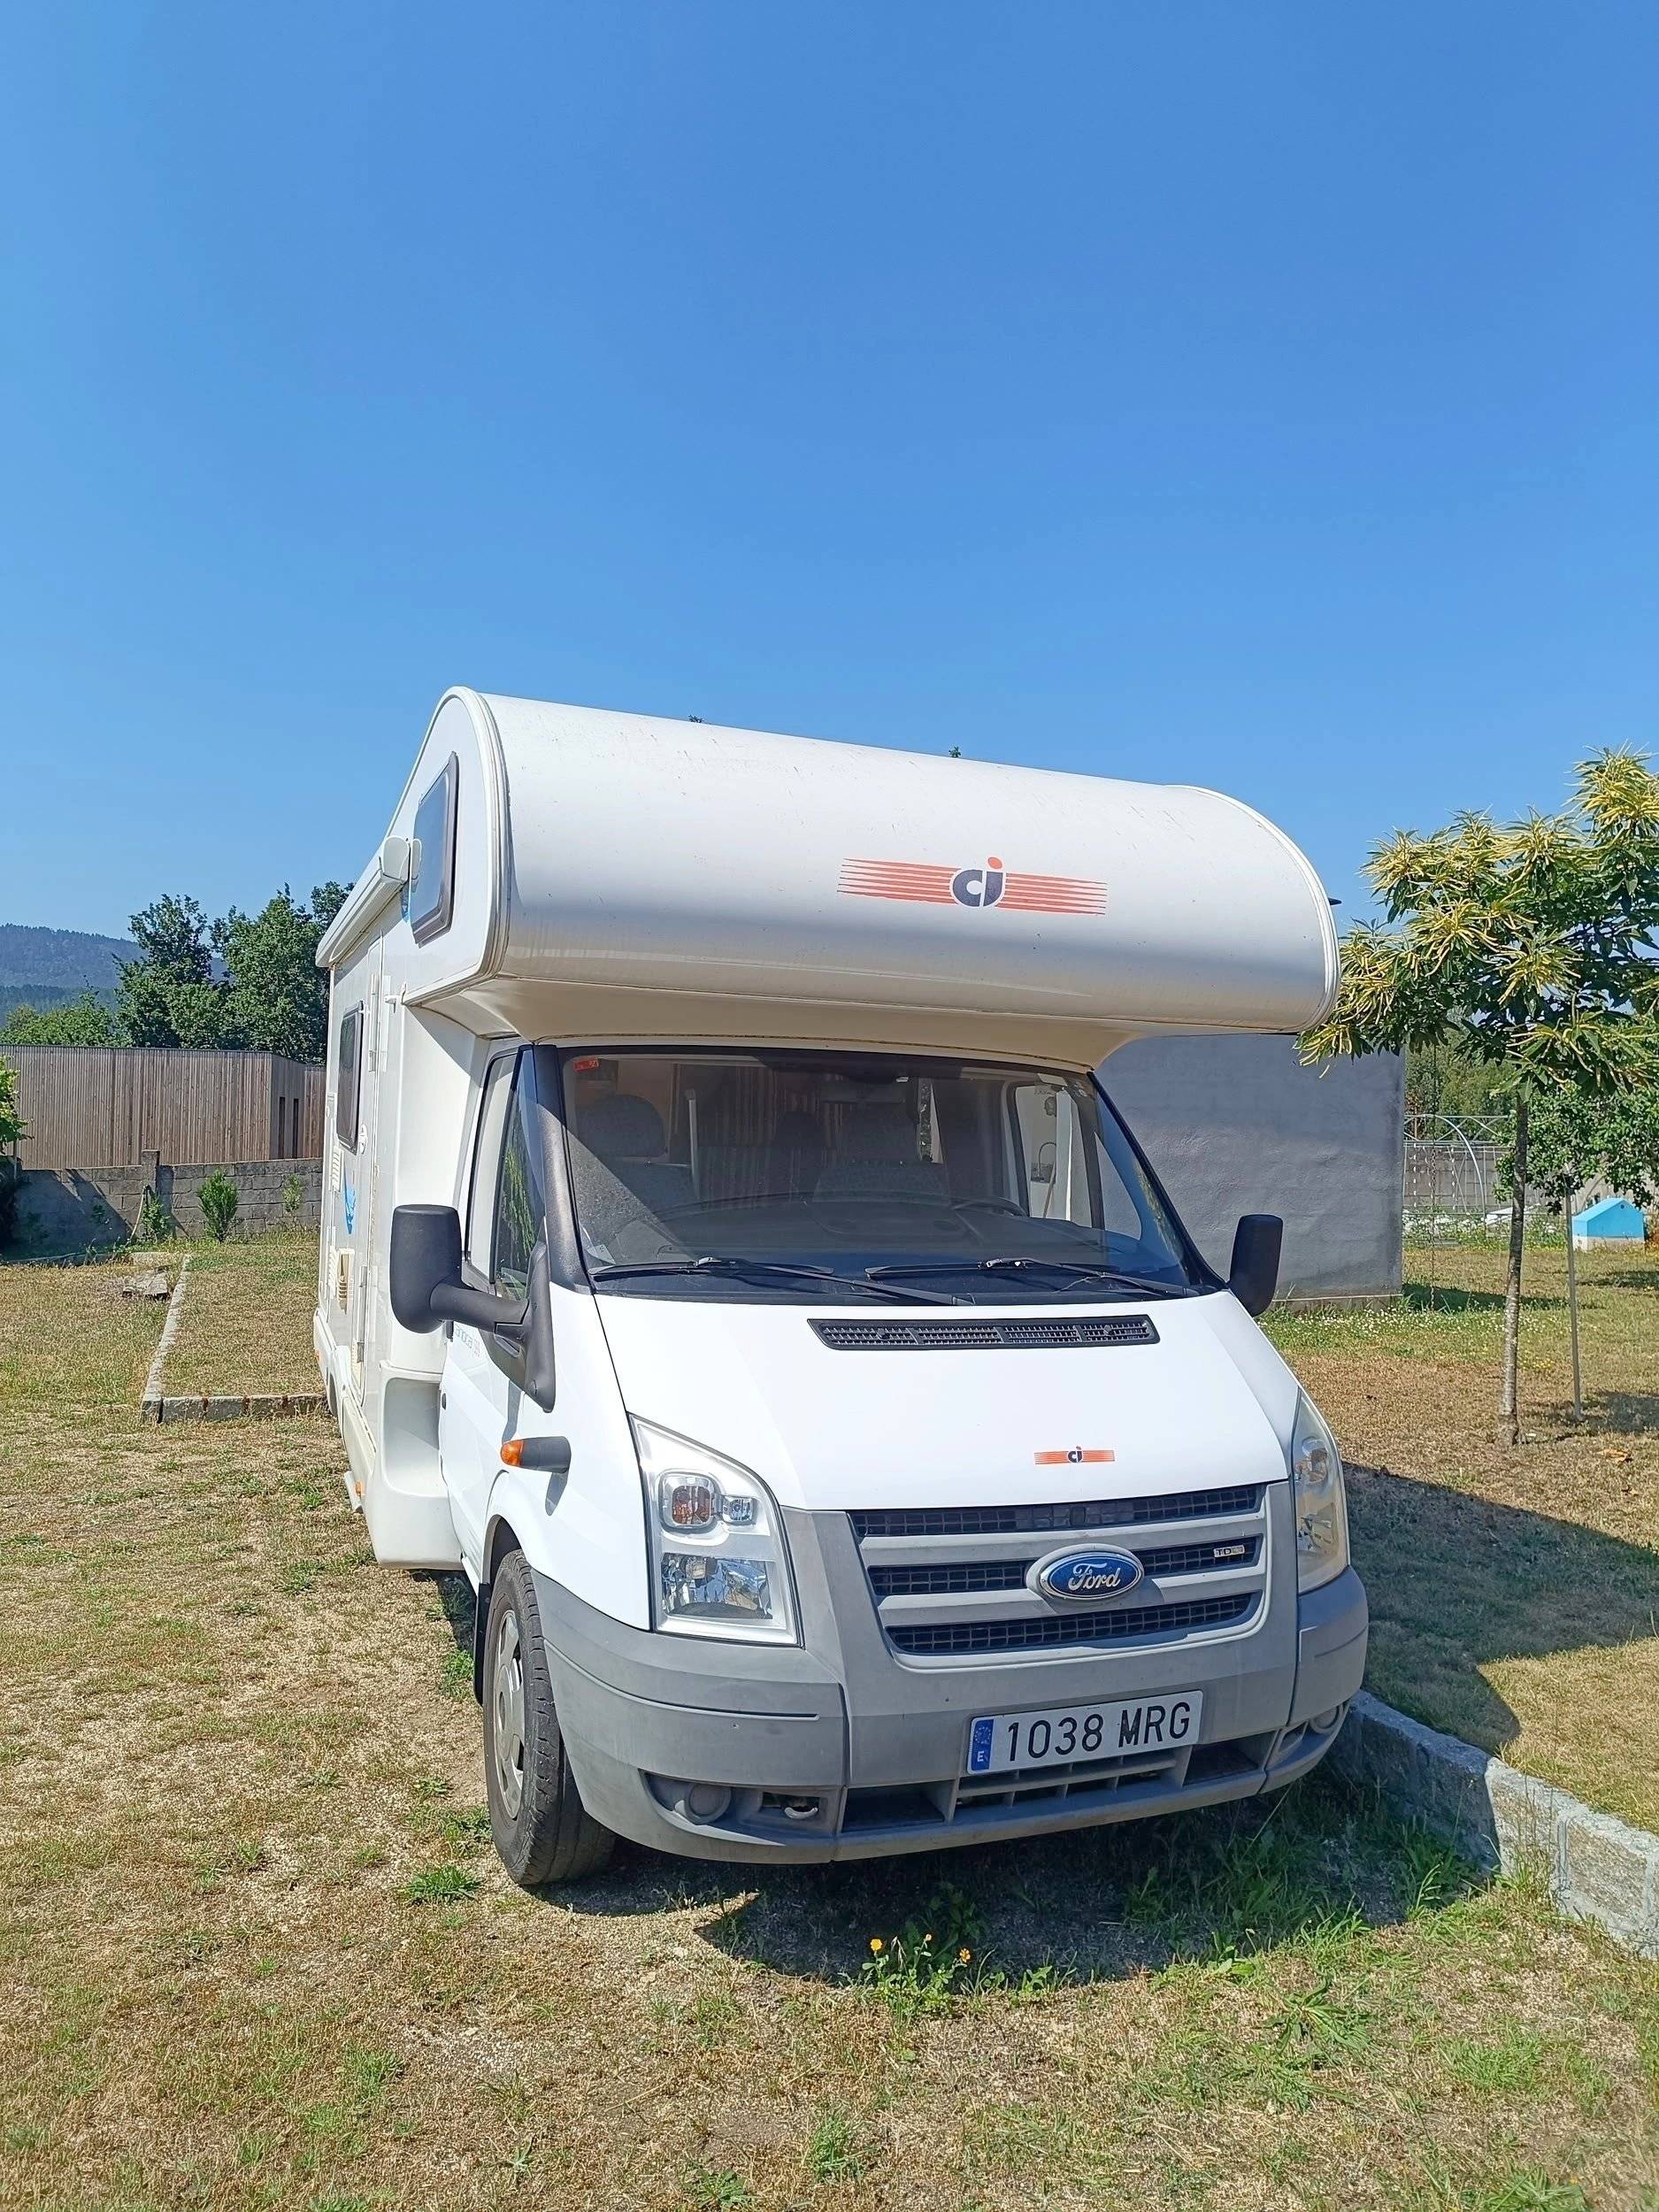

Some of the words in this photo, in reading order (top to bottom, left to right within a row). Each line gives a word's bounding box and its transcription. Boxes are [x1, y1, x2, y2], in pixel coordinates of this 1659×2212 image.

[1067, 1563, 1121, 1591] Ford
[1008, 1714, 1104, 1762] 1038
[1118, 1701, 1191, 1747] MRG
[977, 1750, 985, 1763] E
